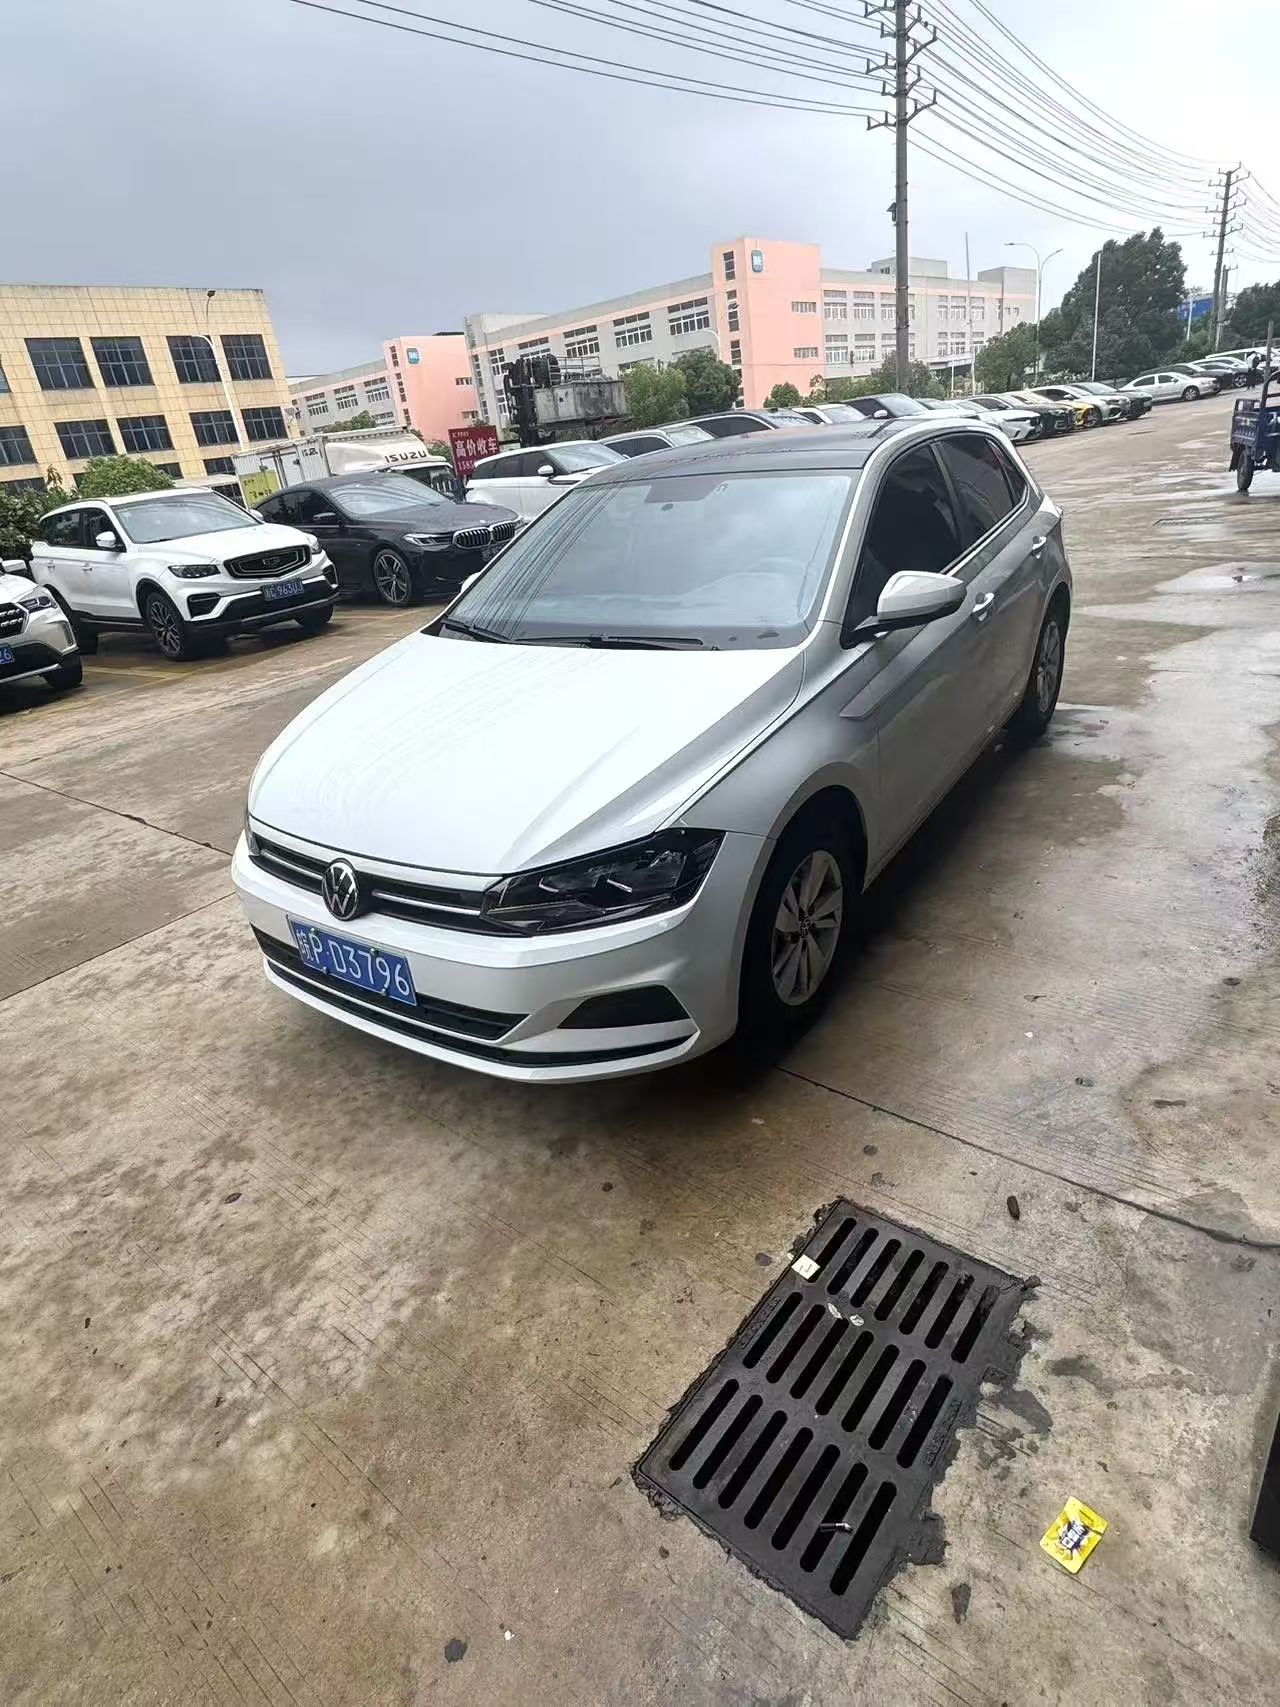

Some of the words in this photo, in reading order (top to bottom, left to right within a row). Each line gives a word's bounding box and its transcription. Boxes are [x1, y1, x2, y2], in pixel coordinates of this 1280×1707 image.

[455, 437, 498, 457] 高价收车
[384, 451, 427, 464] ISUZU
